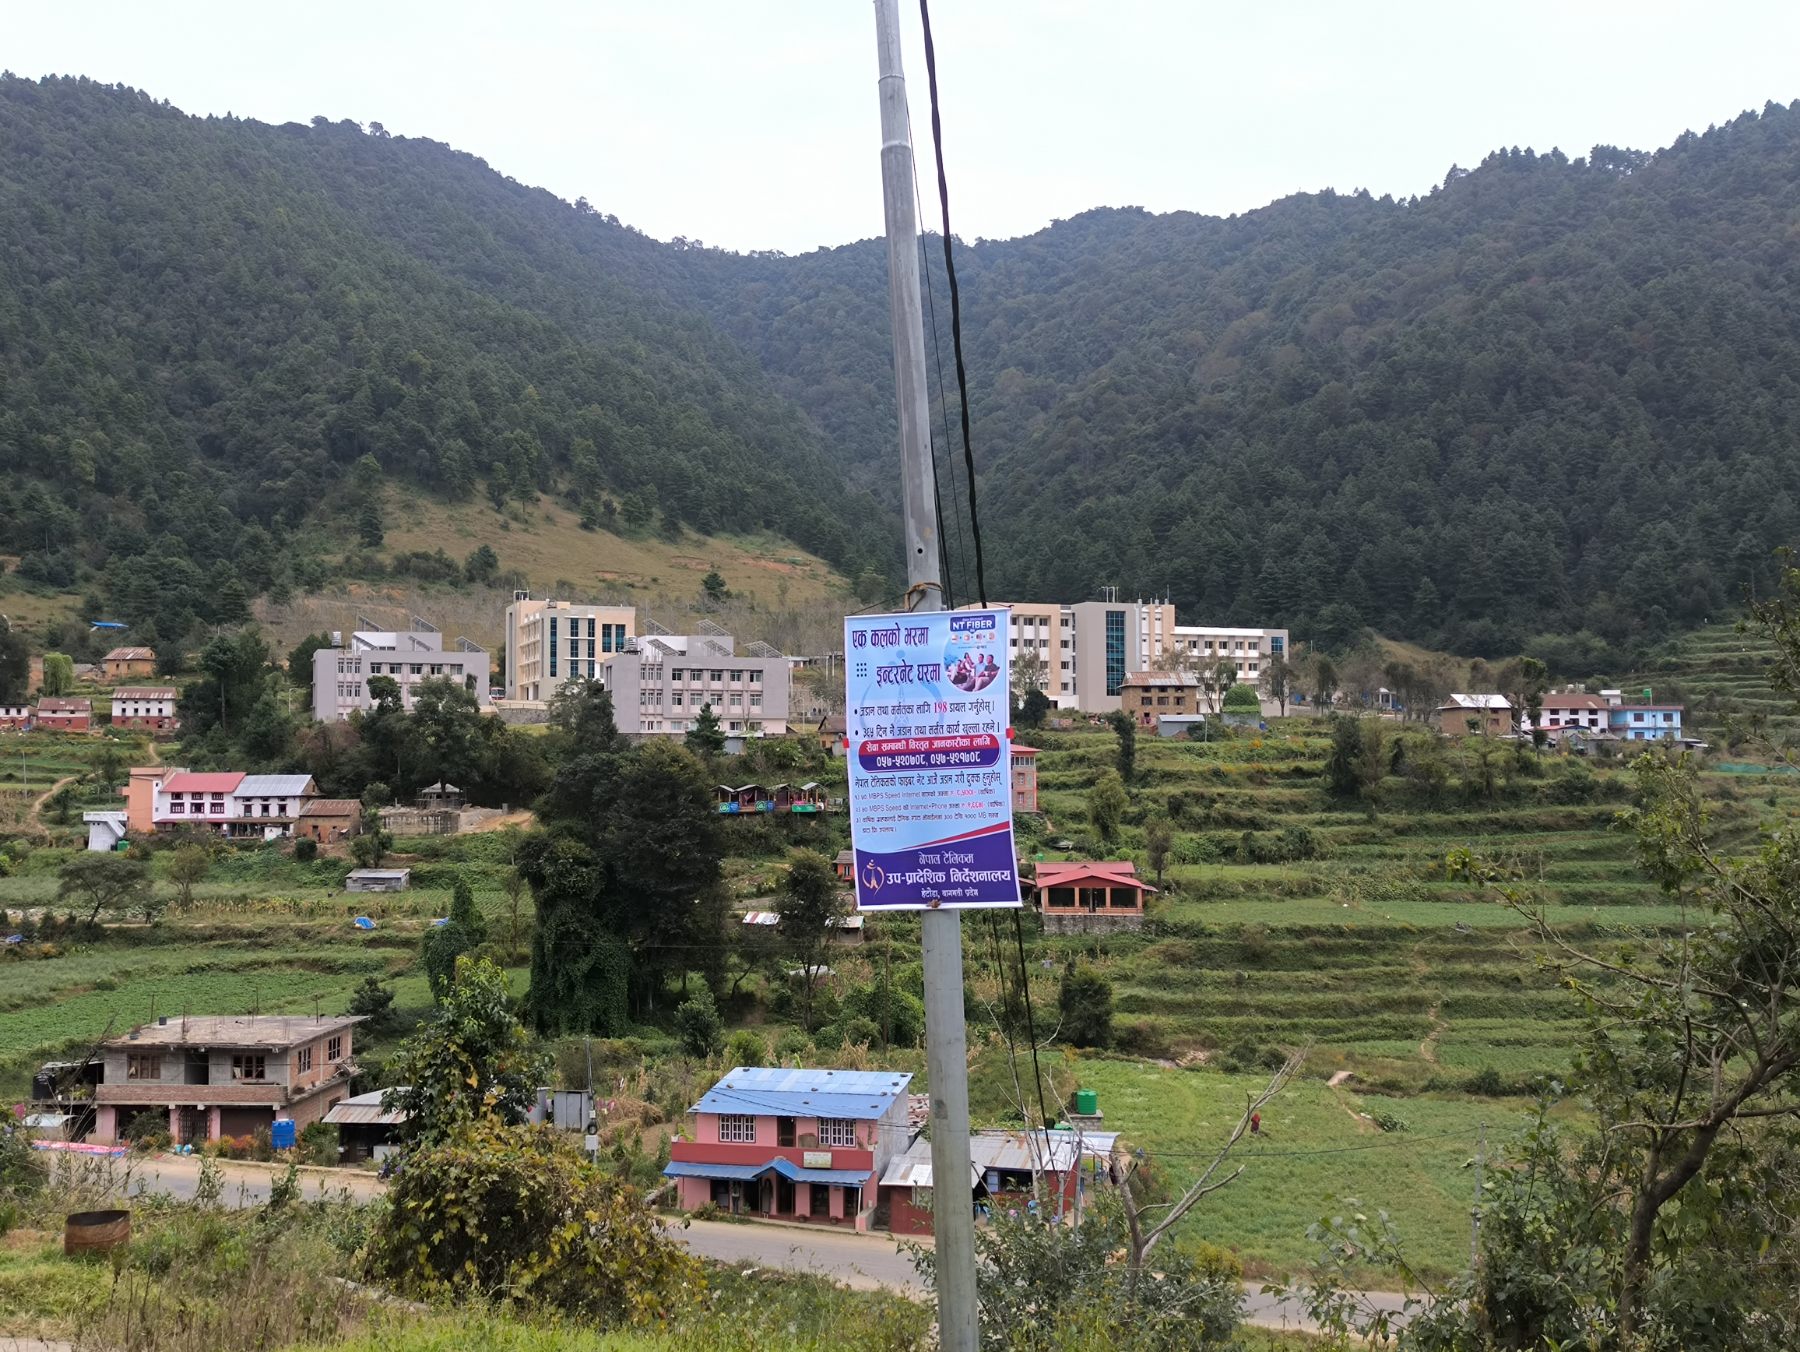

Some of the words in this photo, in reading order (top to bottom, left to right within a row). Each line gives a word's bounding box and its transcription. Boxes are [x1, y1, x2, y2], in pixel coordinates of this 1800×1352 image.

[952, 621, 965, 631] NT
[966, 619, 993, 630] FIBER
[852, 629, 867, 648] एक
[871, 622, 901, 648] कलको
[904, 627, 929, 646] भरमा
[876, 659, 913, 686] इन्टरनेट
[917, 663, 941, 682] घरमा
[877, 705, 889, 716] तथा
[916, 701, 931, 714] लागि
[933, 702, 948, 714] 198
[950, 702, 966, 712] डायल
[876, 724, 887, 737] दिन
[914, 725, 926, 735] तथा
[865, 741, 879, 753] सेवा
[885, 791, 901, 800] Speed
[918, 851, 941, 865] नेपाल
[886, 868, 947, 885] उप-प्रादेशिक
[949, 867, 1012, 884] निर्देशनालय
